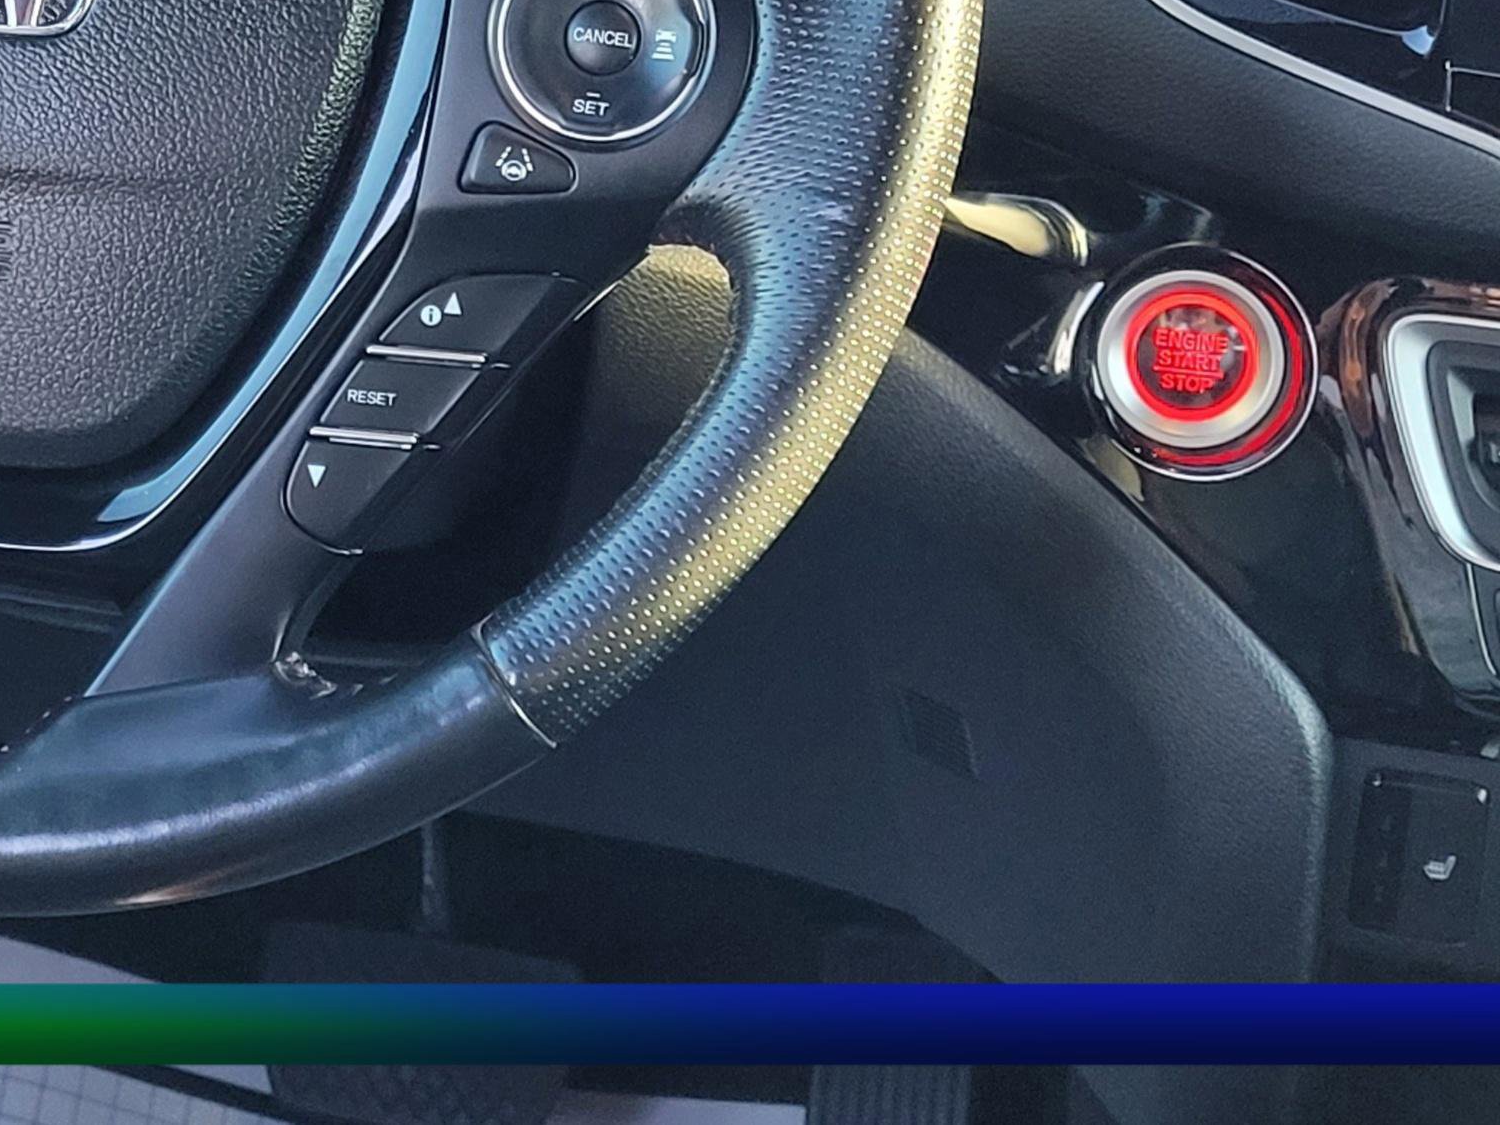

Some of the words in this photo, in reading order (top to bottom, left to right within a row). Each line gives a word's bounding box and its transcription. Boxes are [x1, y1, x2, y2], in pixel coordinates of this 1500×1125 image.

[573, 25, 633, 49] CANCEL
[572, 98, 610, 118] SET
[1155, 329, 1229, 354] ENGINE
[1159, 350, 1222, 372] START
[1160, 374, 1214, 393] STOP
[346, 389, 397, 408] RESET
